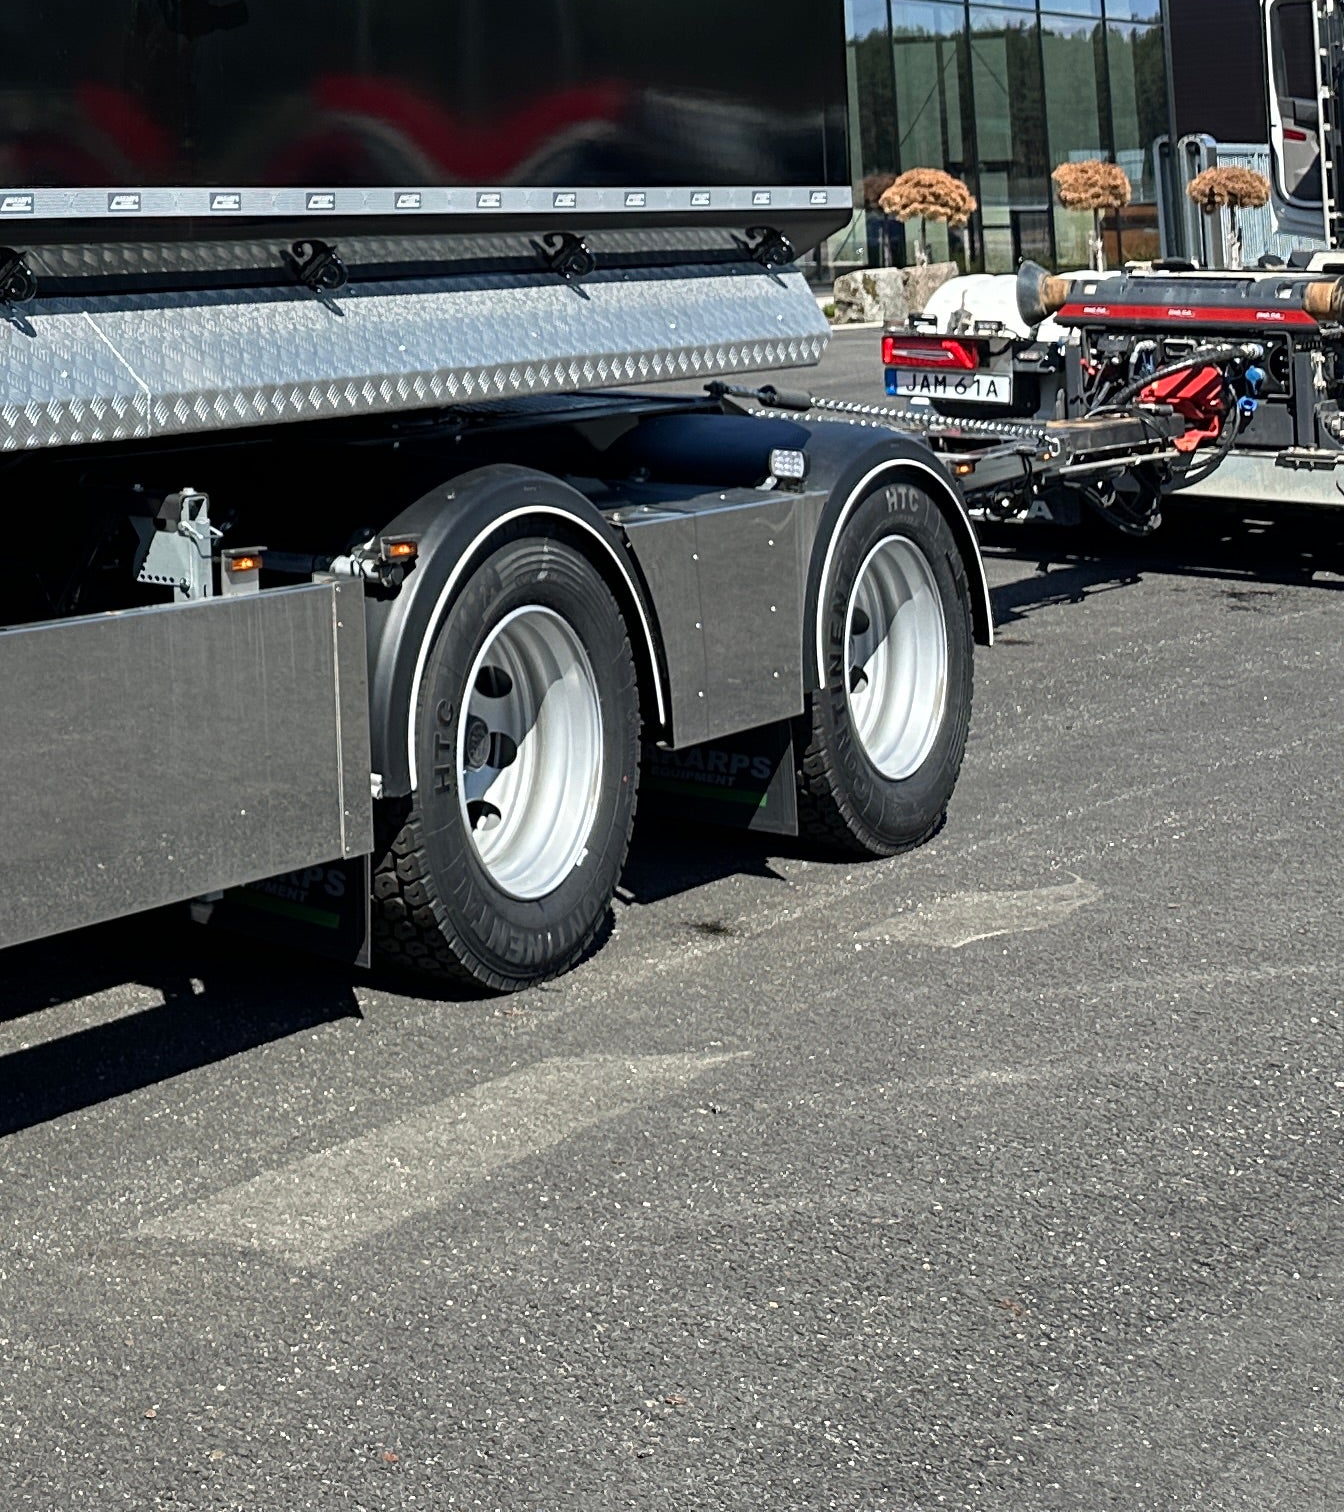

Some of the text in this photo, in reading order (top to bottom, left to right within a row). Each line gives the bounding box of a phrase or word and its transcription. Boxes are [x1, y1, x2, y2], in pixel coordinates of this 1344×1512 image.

[906, 373, 998, 397] JAM 61A
[886, 487, 919, 513] HTC
[434, 697, 456, 795] HTC
